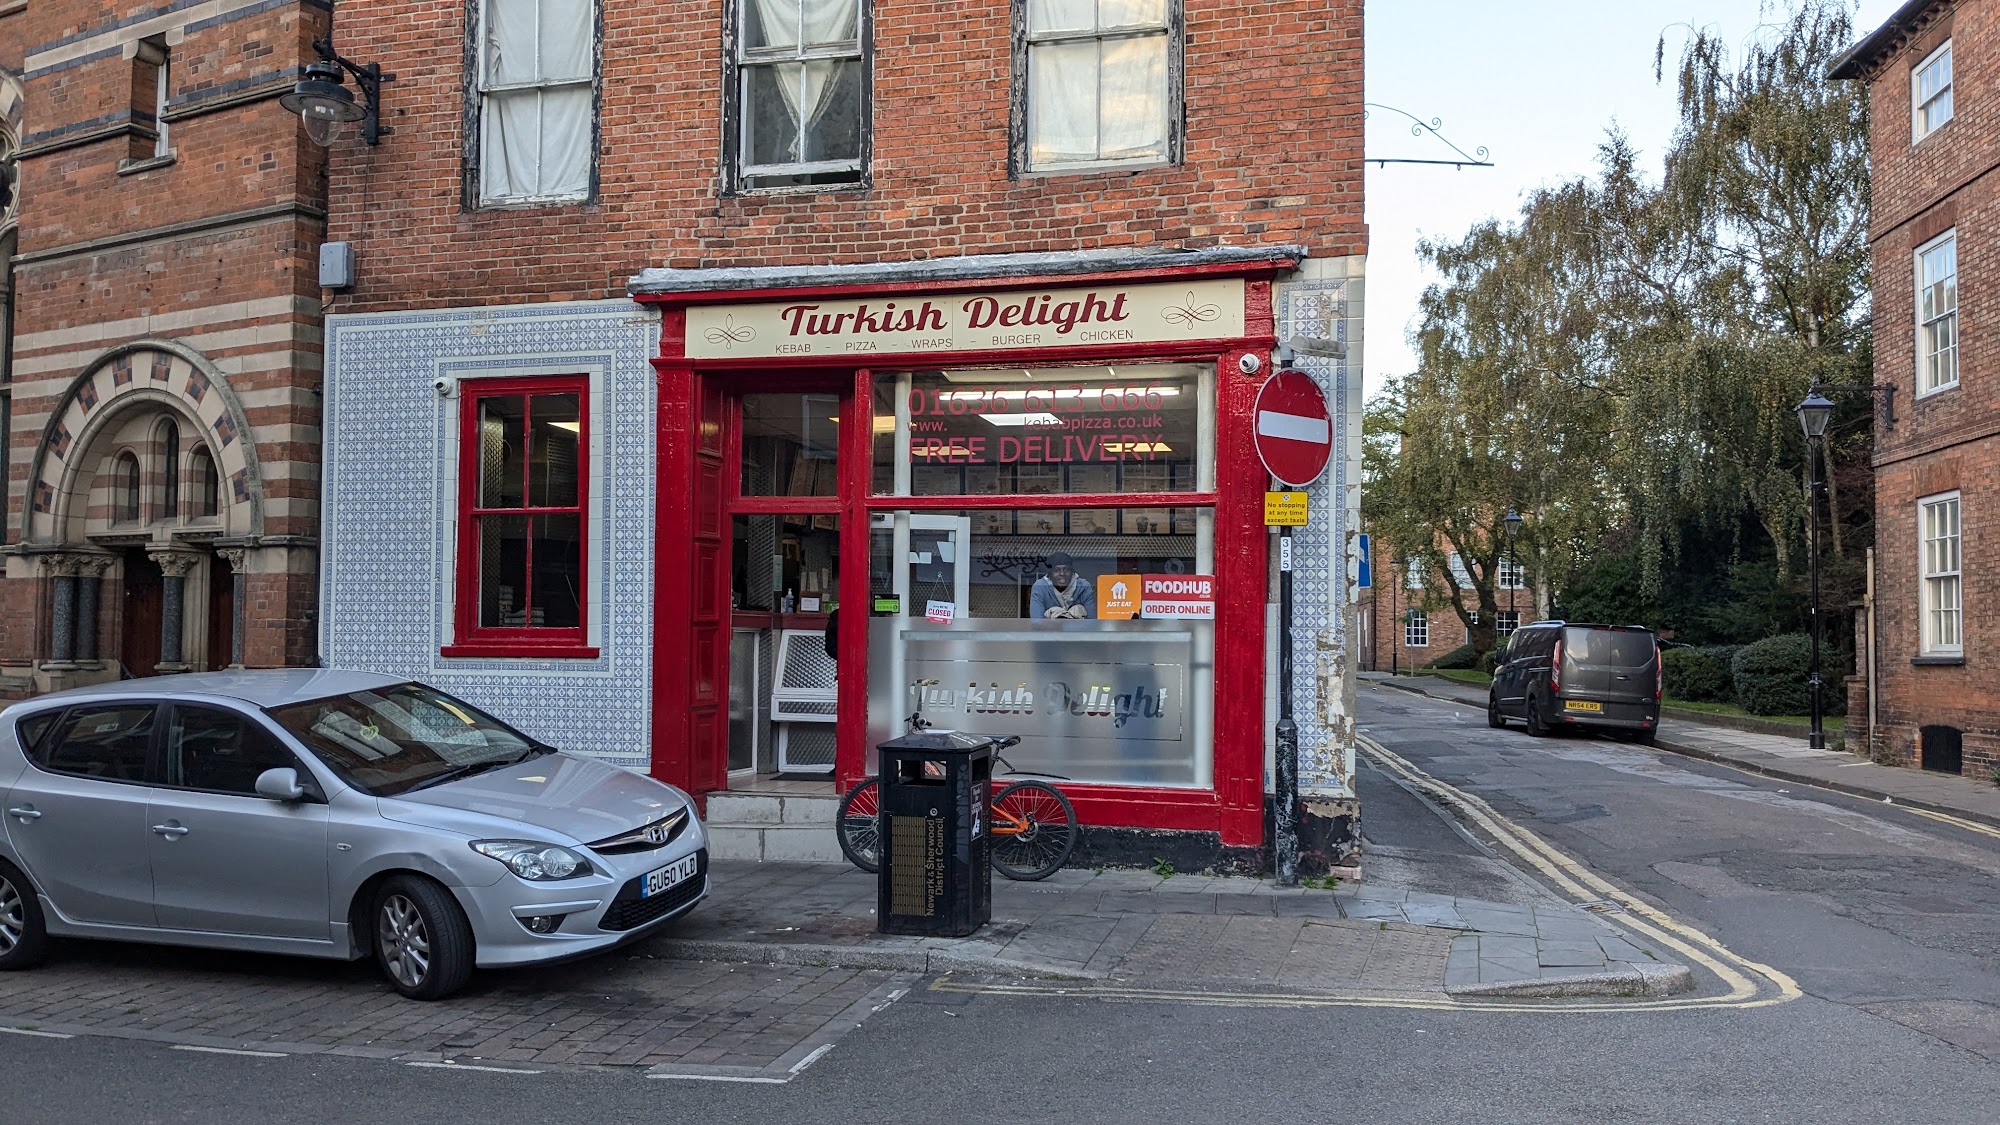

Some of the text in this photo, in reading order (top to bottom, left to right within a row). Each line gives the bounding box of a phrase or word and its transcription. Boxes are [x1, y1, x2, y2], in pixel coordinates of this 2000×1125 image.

[781, 292, 1130, 336] Turkish Delight
[775, 329, 1134, 355] KEBAB PIZZA WRAPS BURGER CHICKEN
[908, 381, 1164, 416] 01636 613 666
[907, 413, 1163, 433] www. kebabpizza.co.uk
[908, 434, 1164, 464] FREE DELIVERY
[1145, 580, 1212, 595] FOODHUB
[928, 608, 951, 617] CLOSED
[1145, 605, 1176, 614] ORDER
[1177, 605, 1211, 614] ONLINE
[910, 678, 1169, 729] Turkish Delight
[926, 819, 935, 870] Sherwood
[935, 818, 944, 896] District Council
[649, 867, 676, 893] GU60
[926, 878, 935, 916] Newark
